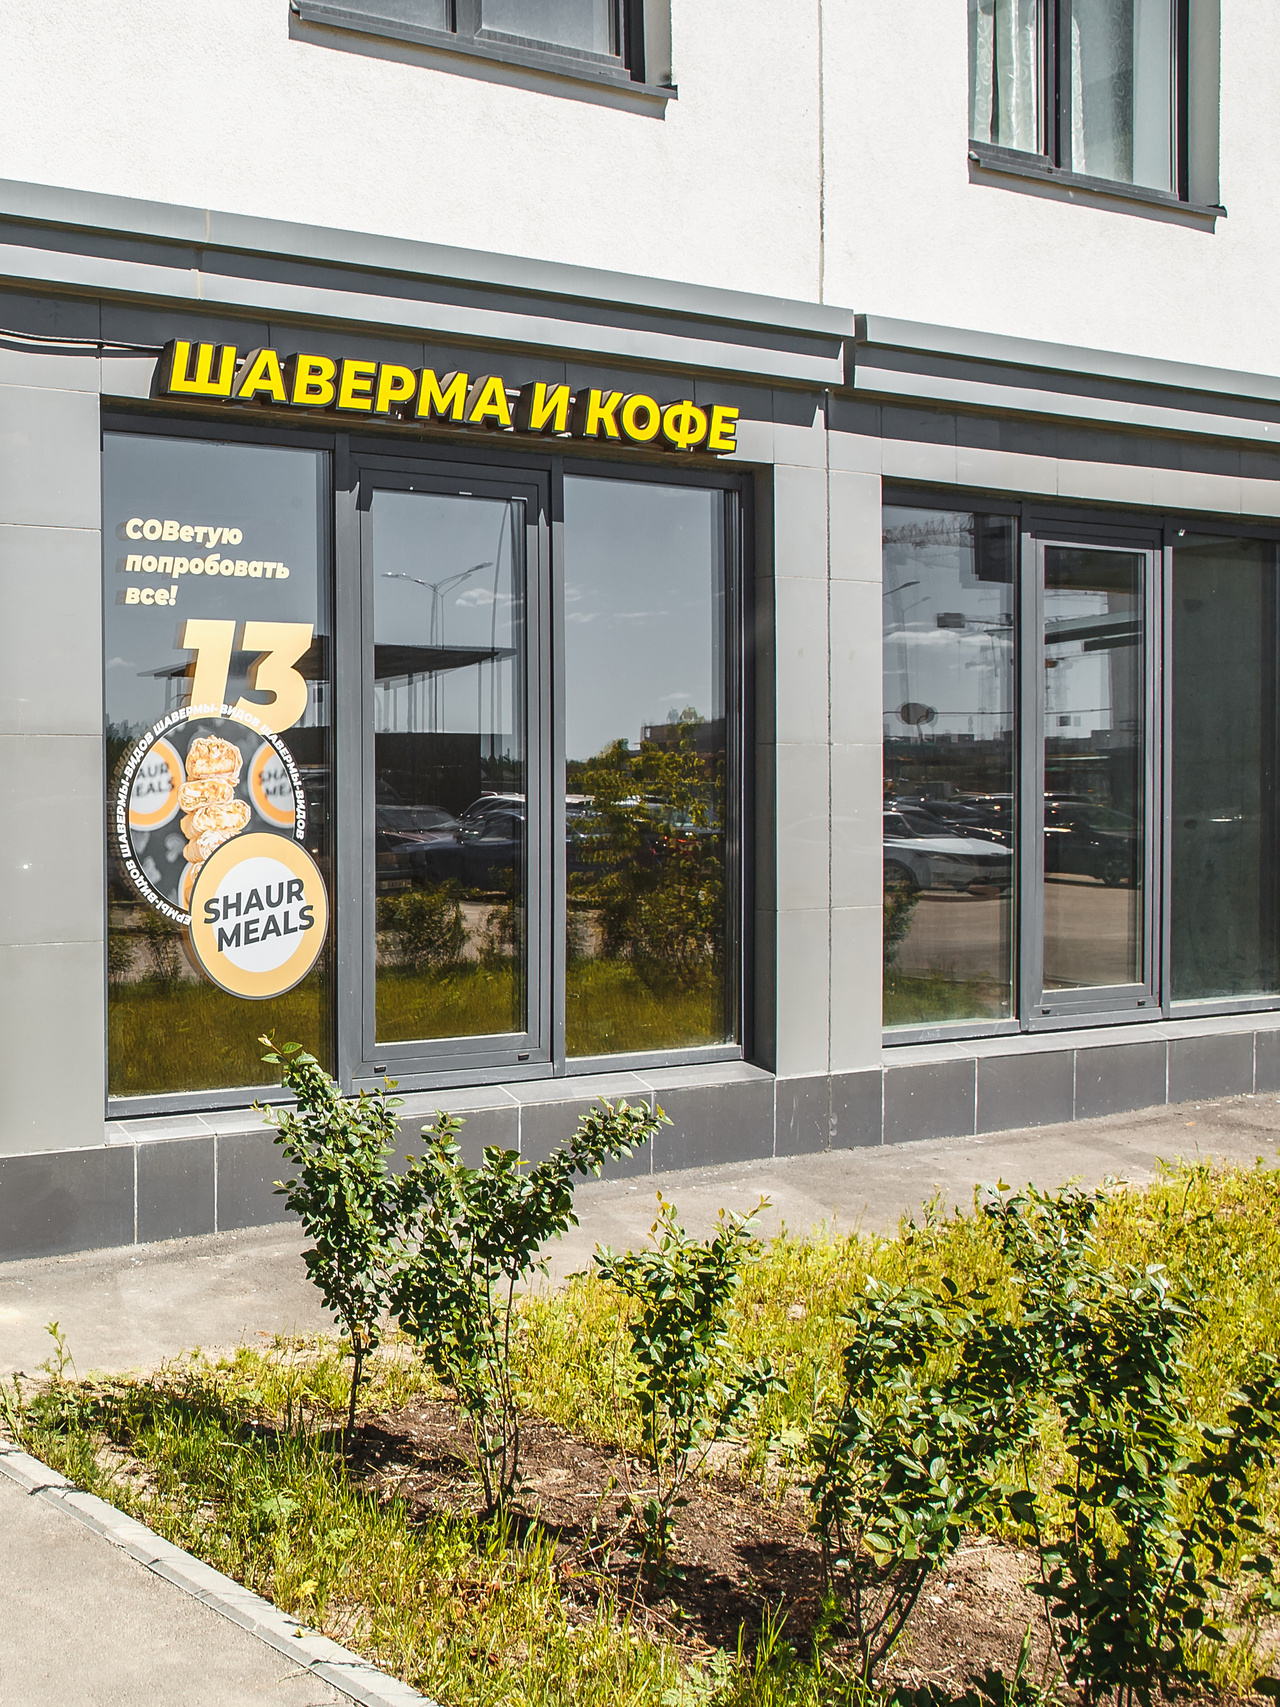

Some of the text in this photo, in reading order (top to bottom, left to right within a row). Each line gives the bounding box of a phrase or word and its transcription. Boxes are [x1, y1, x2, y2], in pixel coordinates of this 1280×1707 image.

[170, 340, 739, 452] ШАВЕРМА И КОФЕ
[125, 517, 243, 549] СОВетую
[125, 553, 290, 580] попробовать
[125, 584, 179, 607] все!
[182, 618, 315, 737] 13
[202, 877, 306, 924] SHAUR
[216, 904, 315, 953] MEALS
